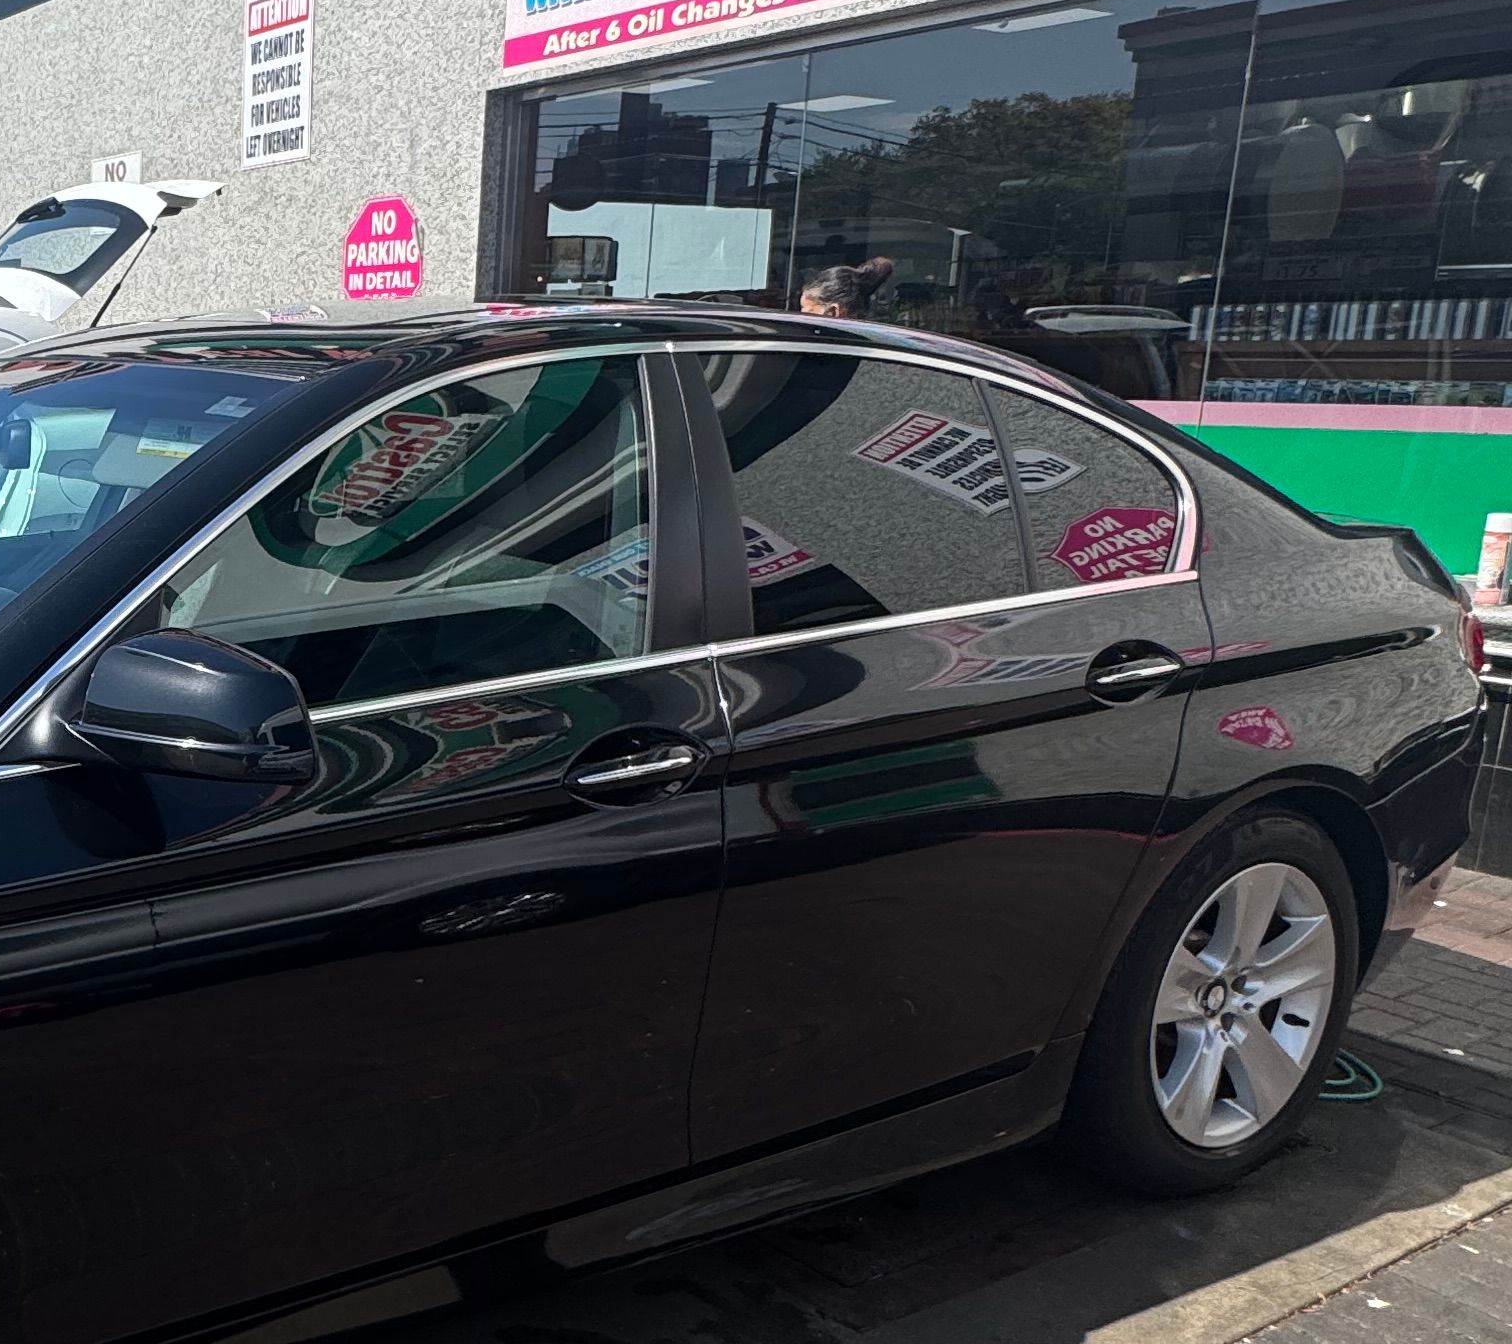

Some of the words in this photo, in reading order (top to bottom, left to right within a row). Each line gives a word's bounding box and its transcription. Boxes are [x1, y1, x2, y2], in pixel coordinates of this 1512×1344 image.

[251, 41, 262, 66] WE
[264, 32, 293, 62] CANNOT
[295, 28, 305, 54] BE
[542, 29, 602, 56] After
[604, 20, 620, 42] 6
[628, 9, 664, 36] Oil
[252, 62, 301, 96] RESPONSIBLE
[251, 103, 264, 127] FOR
[267, 94, 300, 124] VEHICLES
[246, 135, 261, 158] LEFT
[263, 126, 304, 156] OVERNIGHT
[104, 161, 127, 183] NO
[371, 209, 396, 236] NO
[347, 239, 420, 267] PARKING
[349, 273, 363, 290] IN
[365, 270, 415, 291] DETAIL
